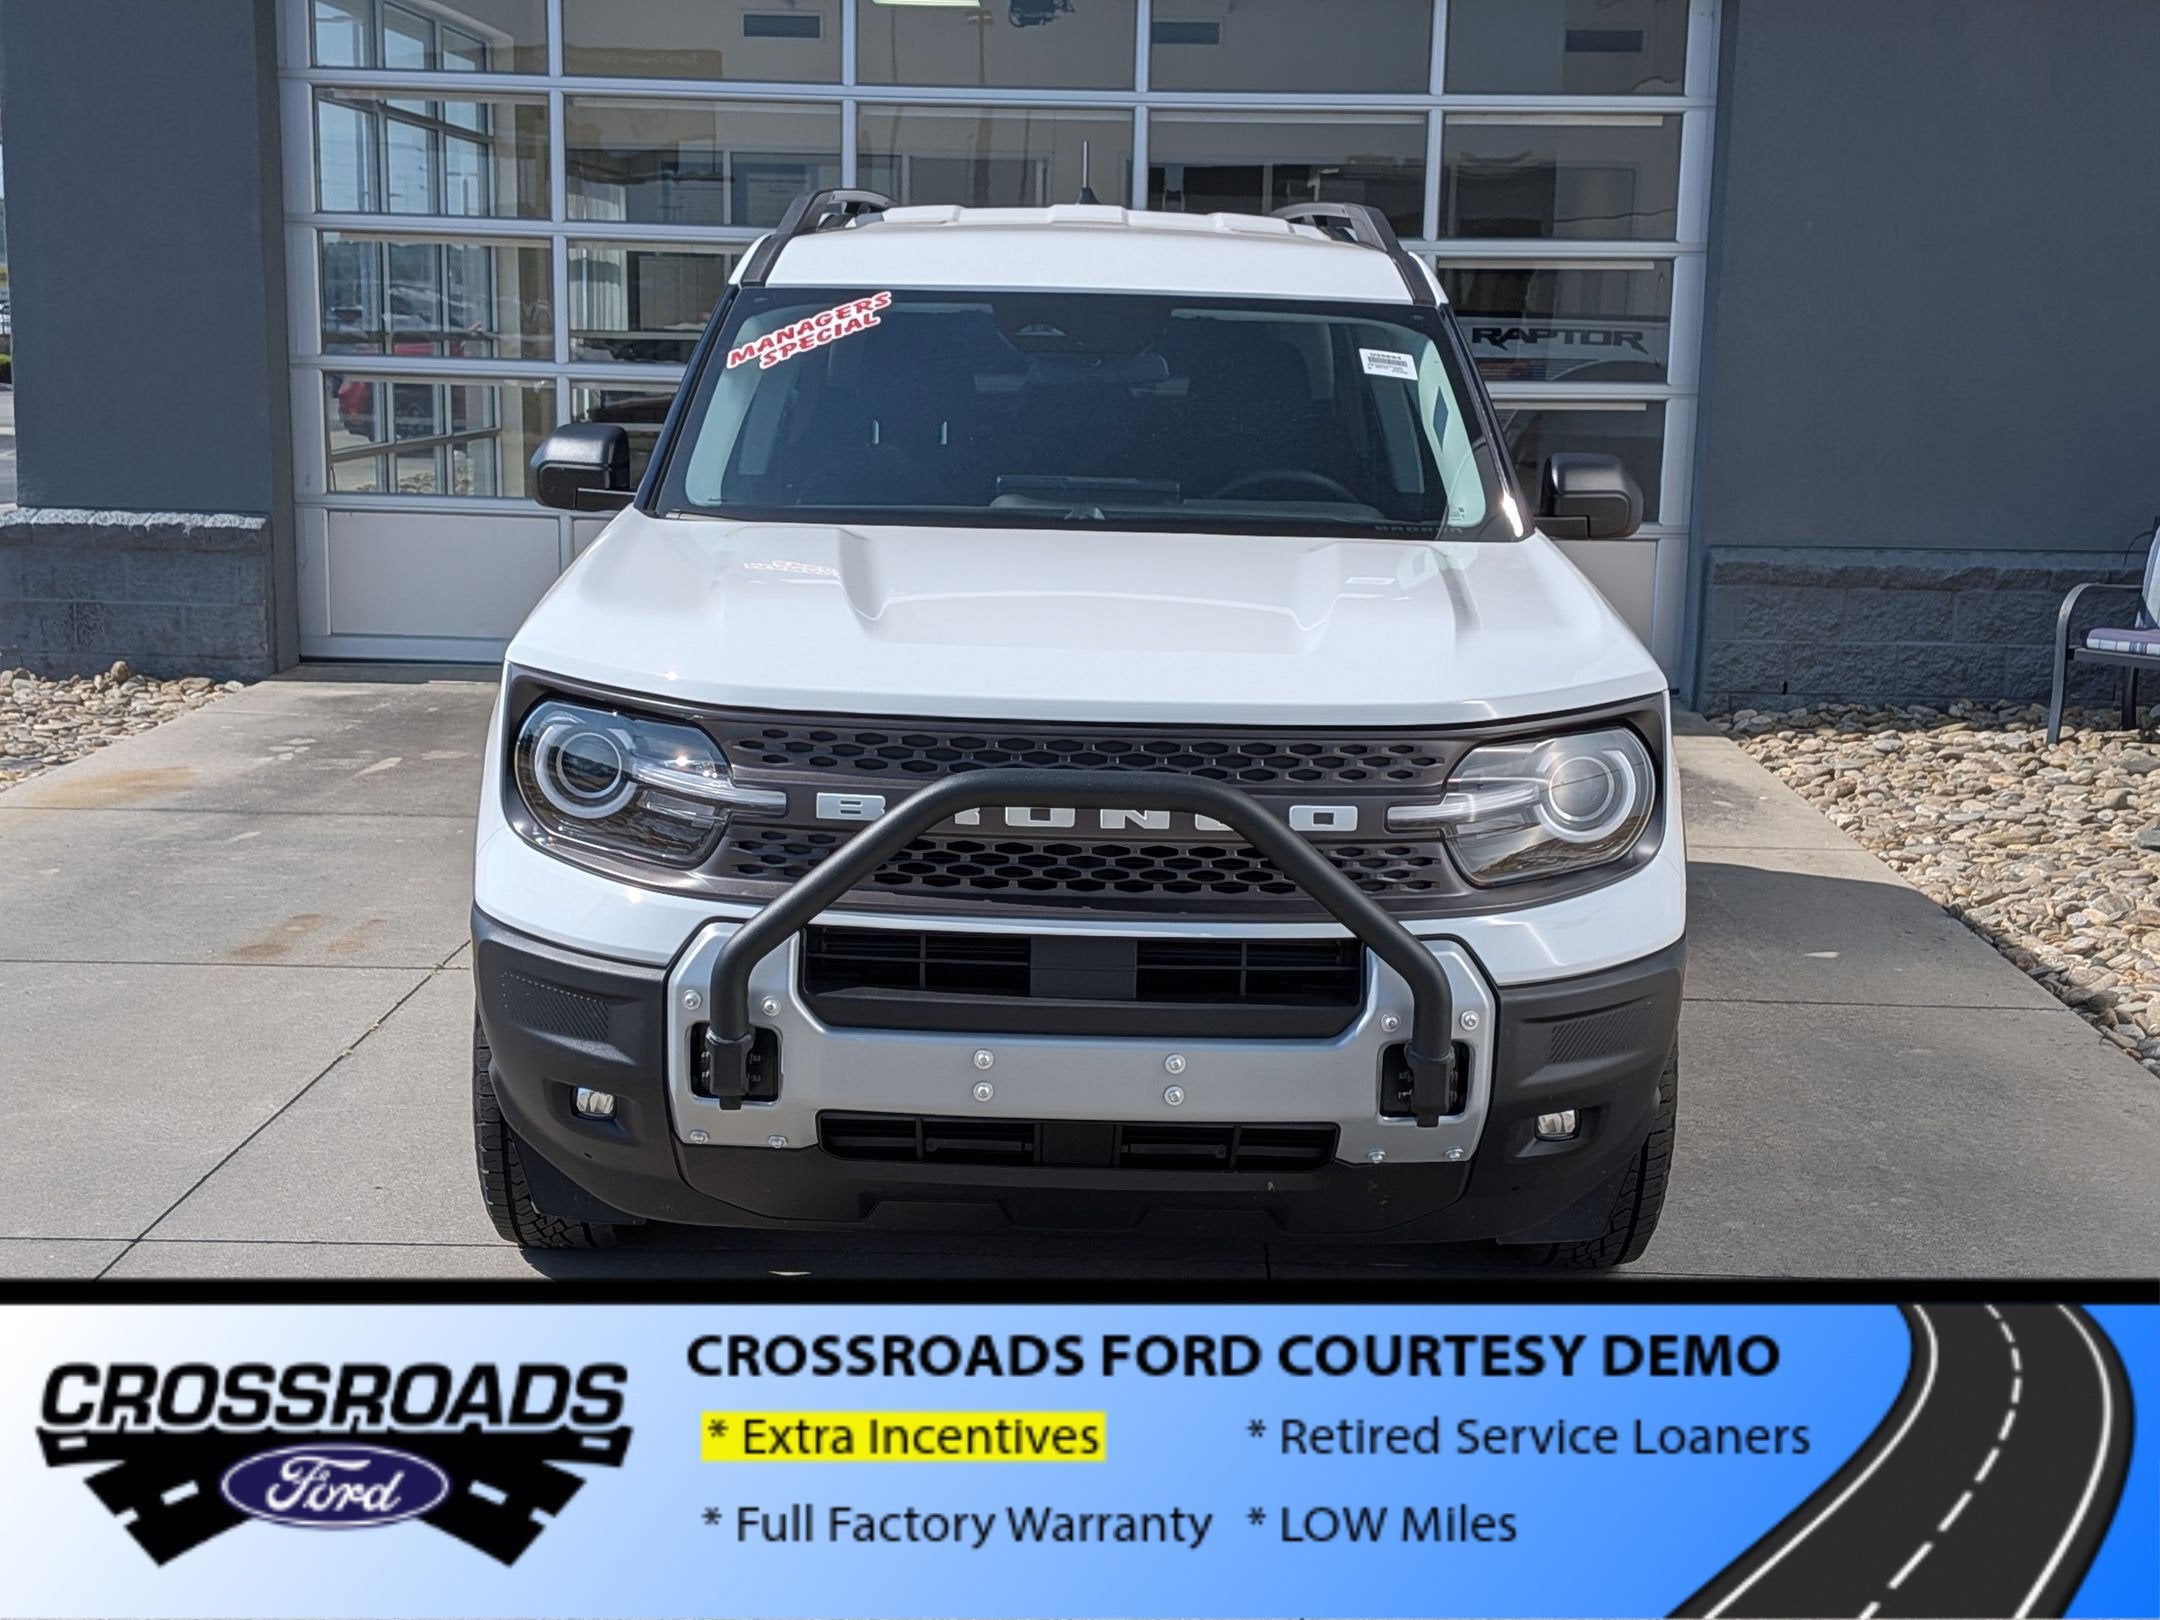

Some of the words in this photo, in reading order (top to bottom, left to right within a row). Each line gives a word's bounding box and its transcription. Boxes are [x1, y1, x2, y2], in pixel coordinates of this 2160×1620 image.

[729, 292, 891, 367] MANAGERS
[761, 312, 879, 368] SPECIAL
[1472, 327, 1649, 355] RAPTOR
